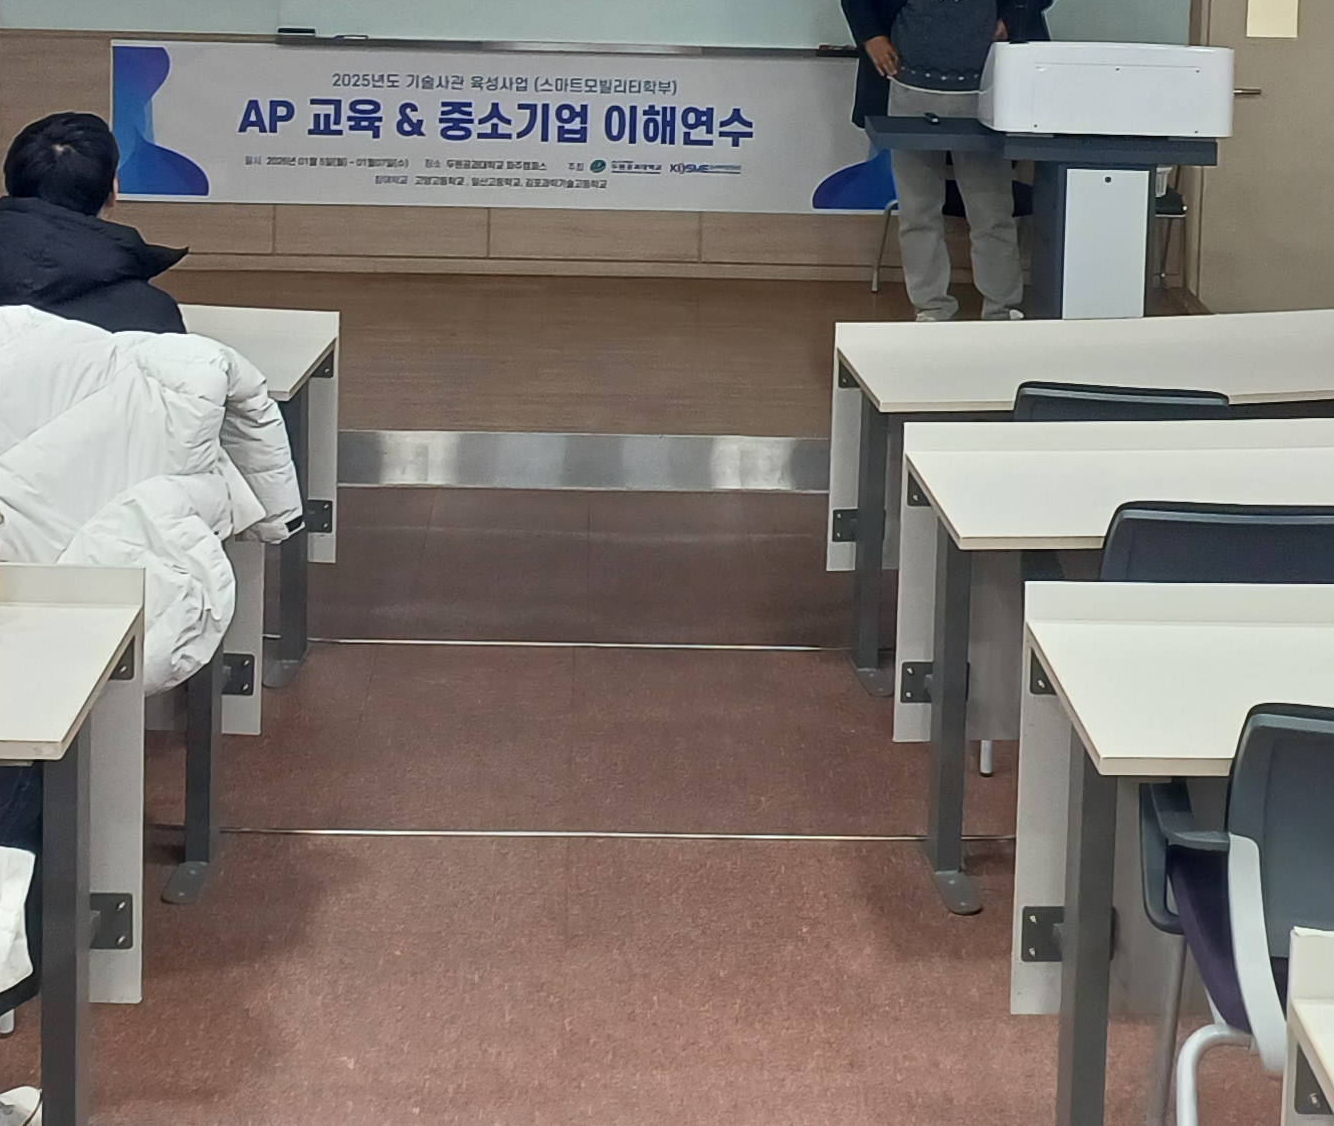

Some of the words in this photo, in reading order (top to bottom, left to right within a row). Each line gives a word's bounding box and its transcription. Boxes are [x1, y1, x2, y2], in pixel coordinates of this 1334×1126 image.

[332, 73, 400, 89] 2025년도
[406, 74, 464, 91] 기술사관
[470, 75, 528, 93] 육성사업
[534, 76, 678, 95] (스마트모빌리티학부)
[238, 99, 295, 134] AP
[308, 98, 383, 139] 교육
[396, 102, 426, 137] &
[438, 101, 589, 144] 중소기업
[605, 103, 754, 148] 이해연수
